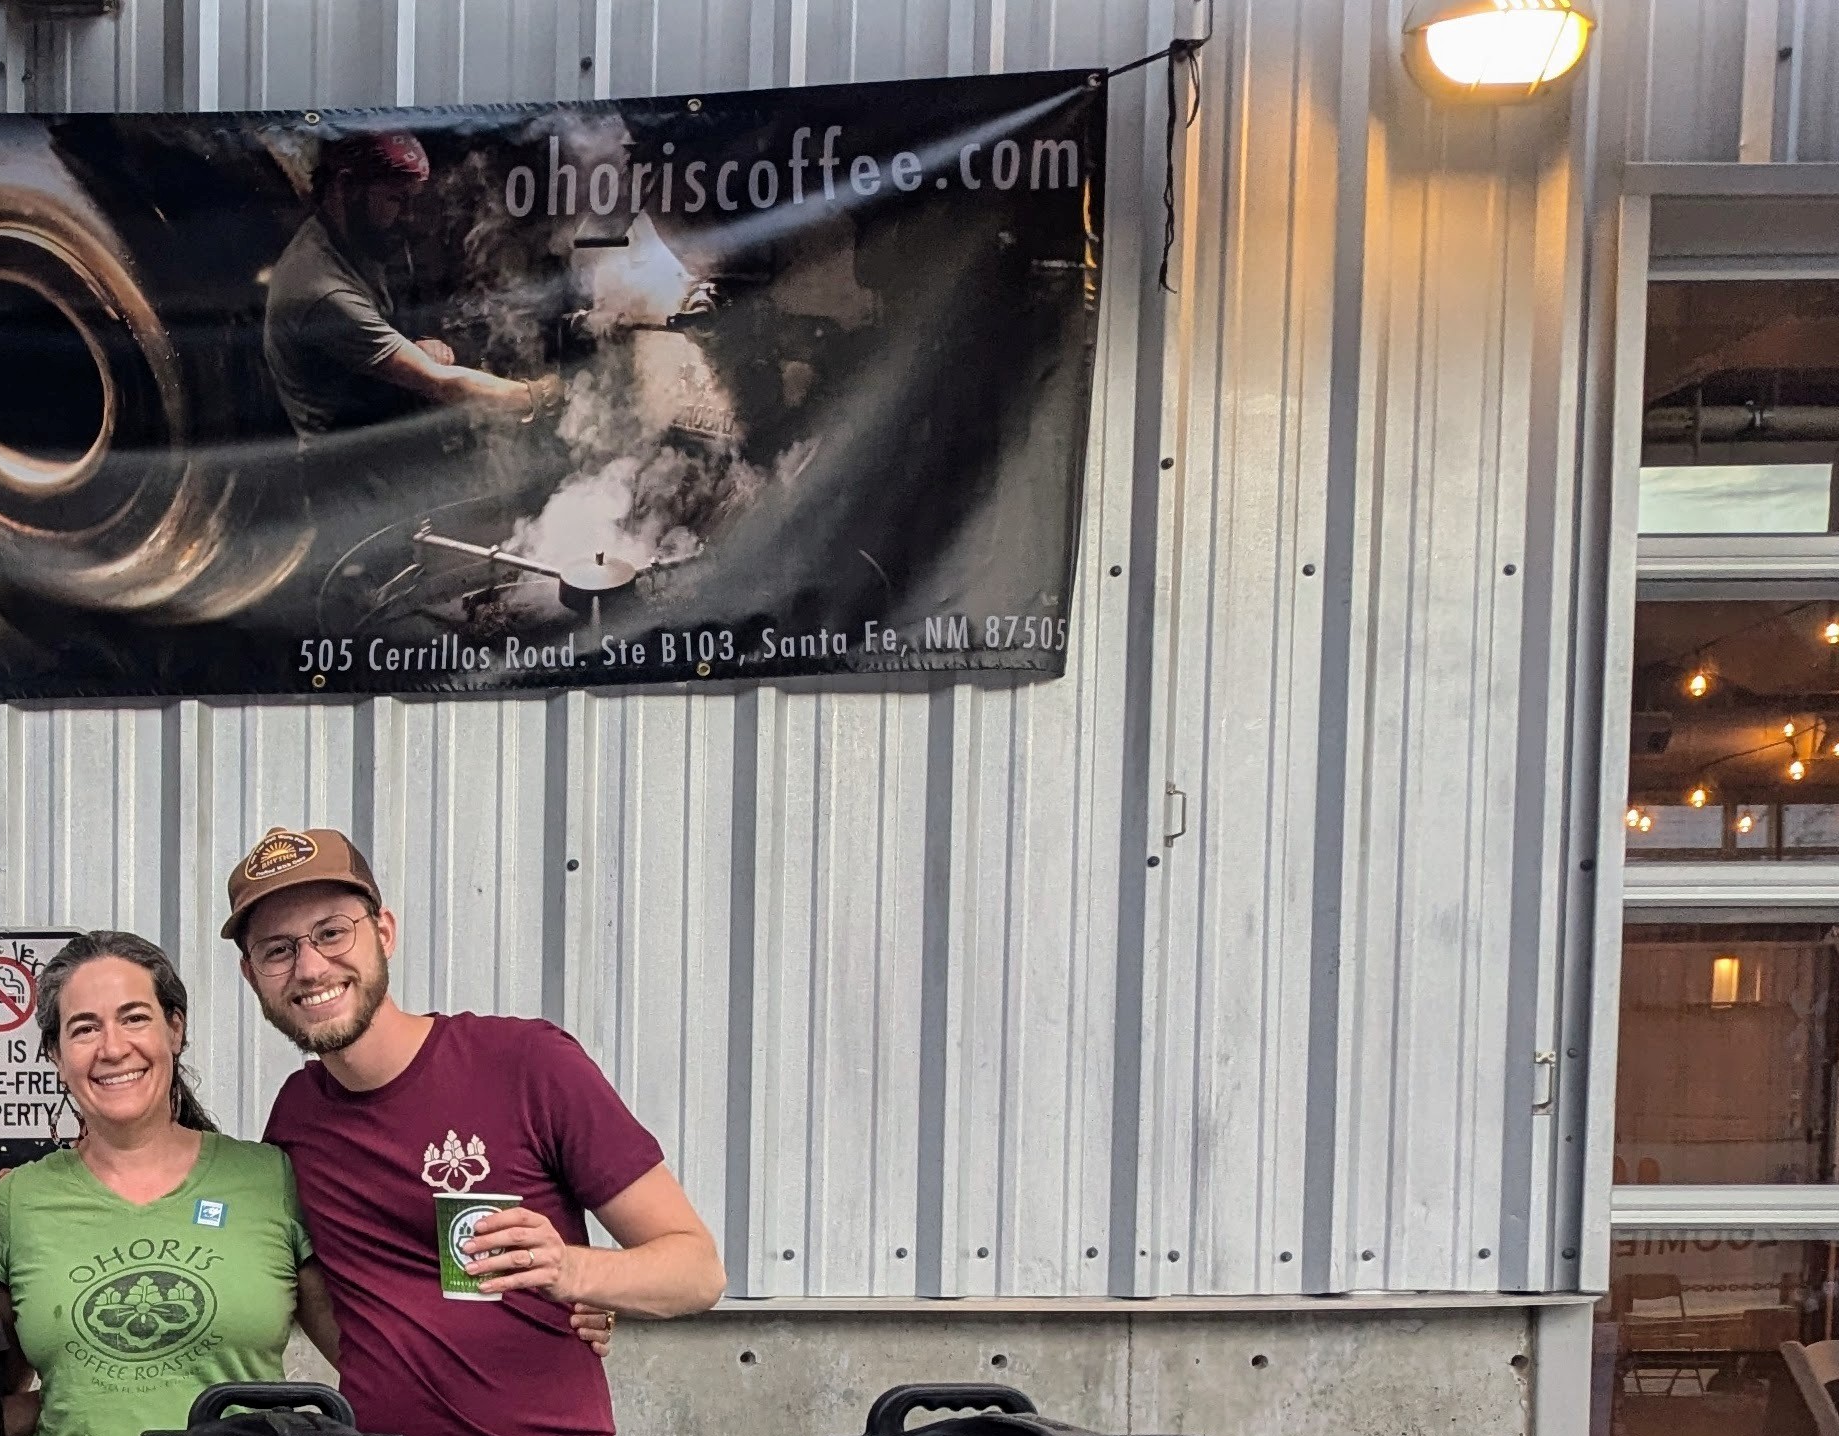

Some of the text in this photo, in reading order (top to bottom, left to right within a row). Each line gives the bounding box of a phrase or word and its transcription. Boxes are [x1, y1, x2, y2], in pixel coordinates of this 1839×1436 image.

[506, 125, 1078, 217] ohoriscoffee.com
[298, 615, 1067, 672] 505 Cerrillos Road. Ste B103, Santa Fe, NM 87505
[7, 1040, 27, 1064] IS
[69, 1239, 224, 1284] OHORI'S
[65, 1340, 128, 1380] COFFEE
[135, 1331, 223, 1380] ROASTERS
